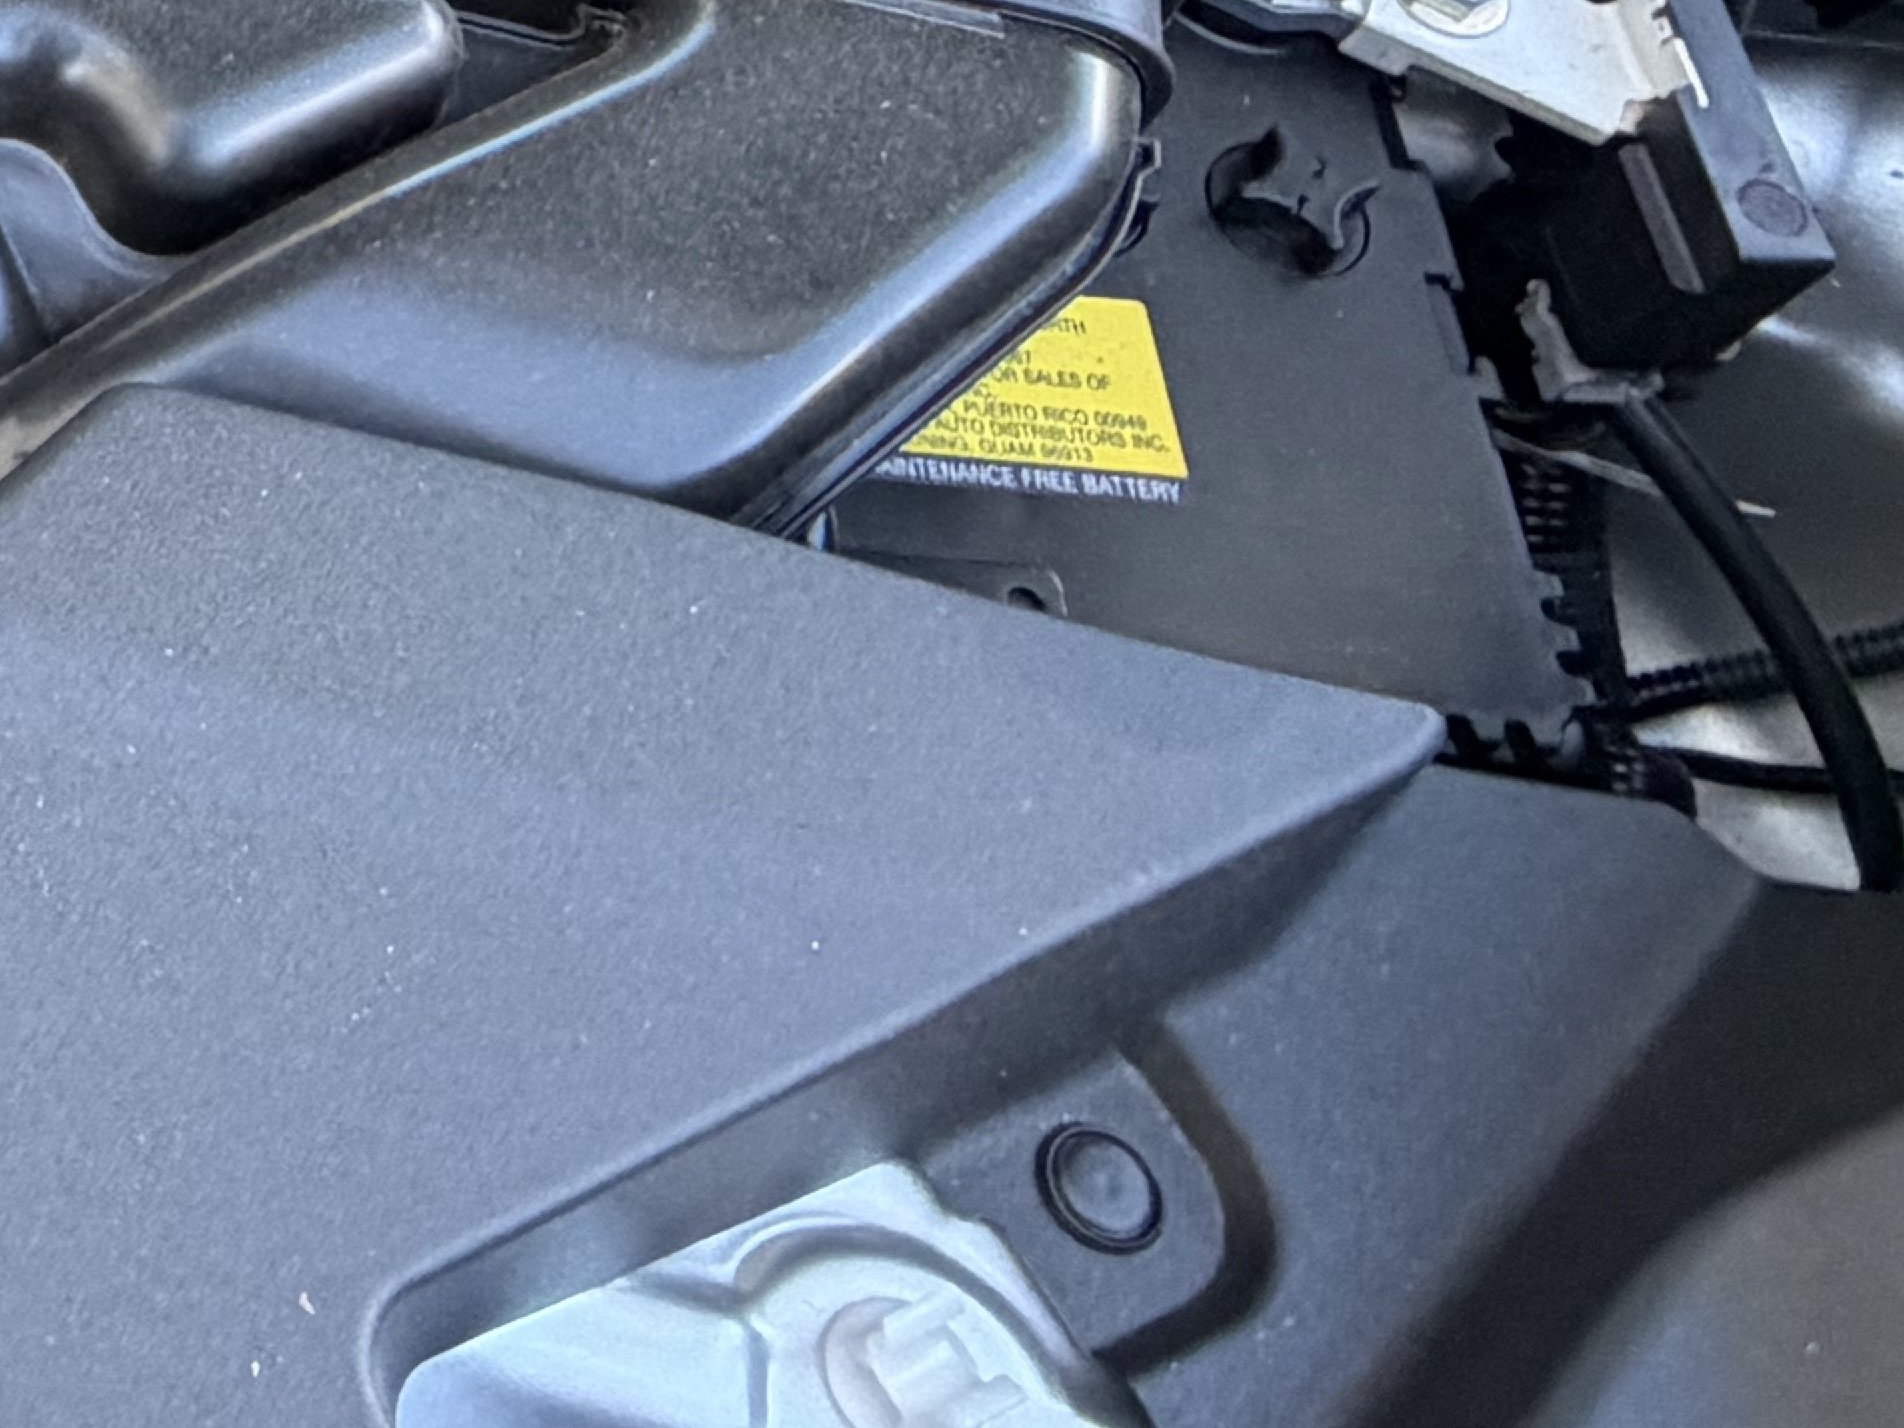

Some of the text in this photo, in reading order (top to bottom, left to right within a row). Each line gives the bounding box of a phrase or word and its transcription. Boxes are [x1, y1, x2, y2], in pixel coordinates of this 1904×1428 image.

[1023, 368, 1081, 388] SALES
[1086, 372, 1110, 390] OF
[963, 399, 1037, 421] PUERTO
[990, 418, 1127, 448] DISTRIBUTORS
[1021, 466, 1079, 494] FREE
[1081, 472, 1180, 505] BATTERY
